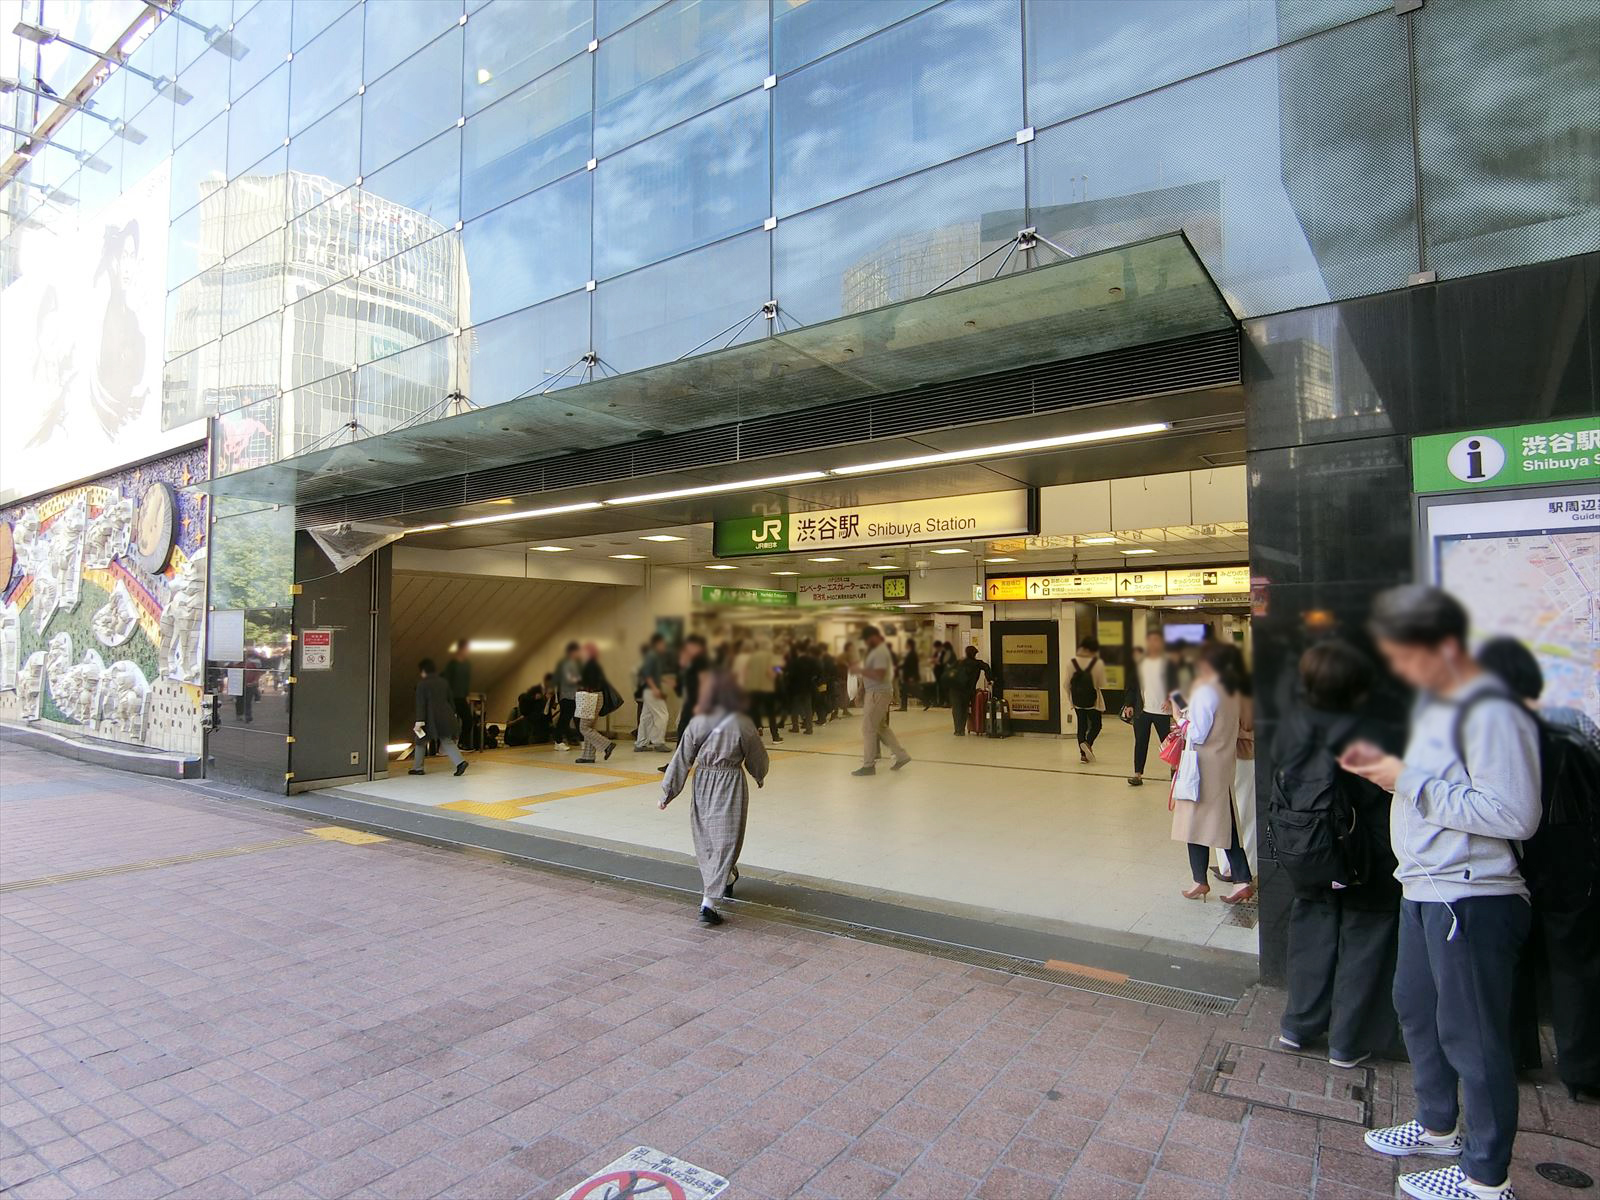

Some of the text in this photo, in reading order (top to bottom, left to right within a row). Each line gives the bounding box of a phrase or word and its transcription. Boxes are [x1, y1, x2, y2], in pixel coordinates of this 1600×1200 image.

[1522, 430, 1600, 457] 渋谷駅
[1523, 457, 1589, 471] Shibuya
[1549, 499, 1600, 513] 駅周辺
[1571, 513, 1600, 521] Guide
[751, 519, 782, 542] JR
[797, 514, 976, 542] 渋谷駅 Shibuya Station
